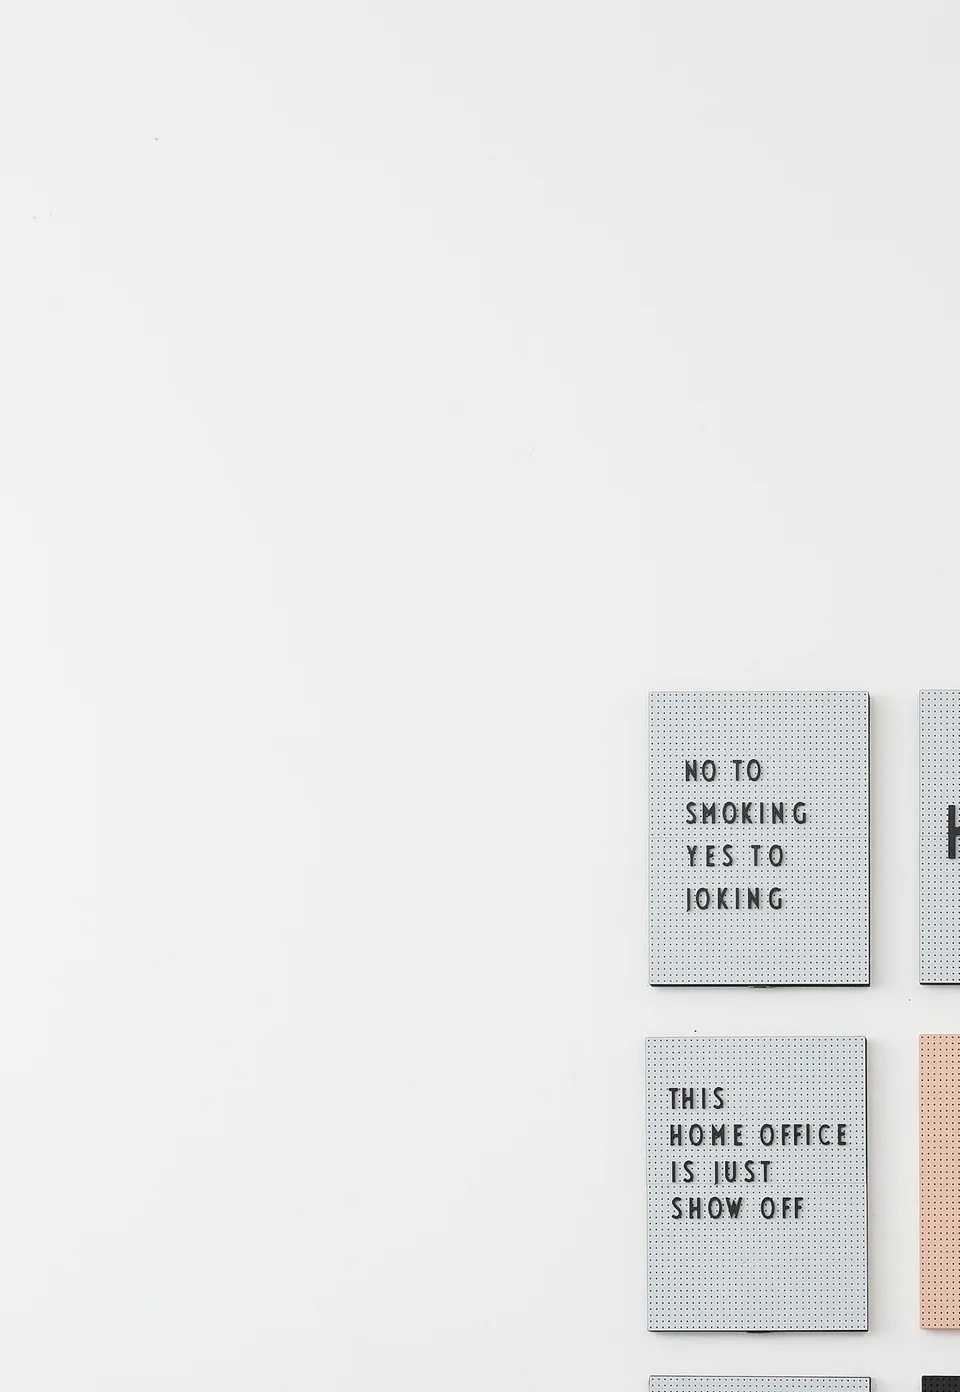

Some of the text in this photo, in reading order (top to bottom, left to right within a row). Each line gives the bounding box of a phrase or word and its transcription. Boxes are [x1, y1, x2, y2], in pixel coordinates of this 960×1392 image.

[685, 758, 762, 783] NO TO
[685, 801, 807, 825] SMOKING
[686, 843, 784, 867] YES TO
[686, 887, 782, 912] JOKING
[668, 1086, 724, 1110] THIS
[670, 1123, 847, 1147] HOME OFFICE
[671, 1159, 771, 1185] IS JUST
[671, 1196, 804, 1220] SHOW OFF
